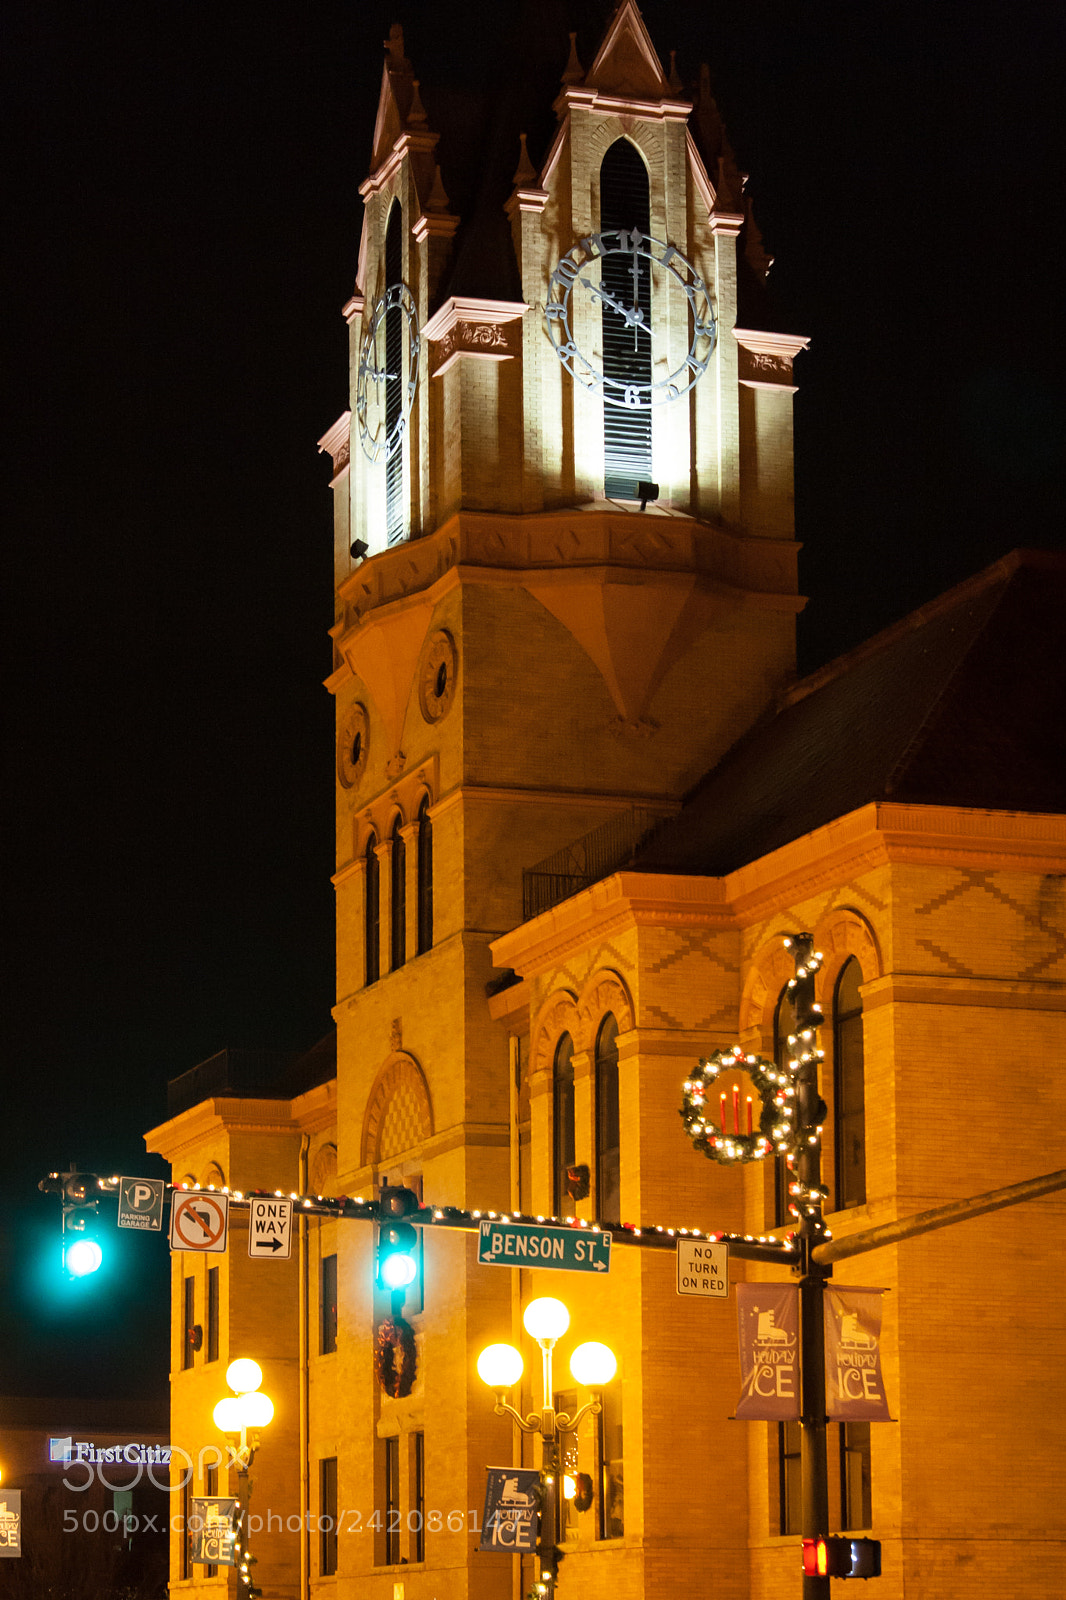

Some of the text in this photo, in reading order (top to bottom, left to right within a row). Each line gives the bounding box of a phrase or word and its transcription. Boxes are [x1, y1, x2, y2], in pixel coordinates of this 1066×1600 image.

[552, 258, 580, 290] 10
[546, 302, 568, 320] 9
[694, 317, 716, 336] 3
[556, 340, 577, 362] 8
[685, 354, 708, 376] 4
[623, 384, 642, 408] 6
[134, 1185, 151, 1208] P
[121, 1212, 150, 1221] PARKING
[256, 1204, 287, 1218] ONE
[120, 1219, 150, 1228] GARAGE
[255, 1220, 287, 1234] WAY
[482, 1223, 491, 1237] W
[491, 1232, 597, 1262] BENSON ST
[603, 1233, 611, 1247] E
[694, 1247, 713, 1259] NO
[688, 1262, 718, 1275] TURN
[682, 1277, 724, 1290] ON RED
[748, 1364, 795, 1398] ICE
[837, 1367, 881, 1400] ICE
[491, 1520, 531, 1548] ICE
[200, 1538, 231, 1560] ICE
